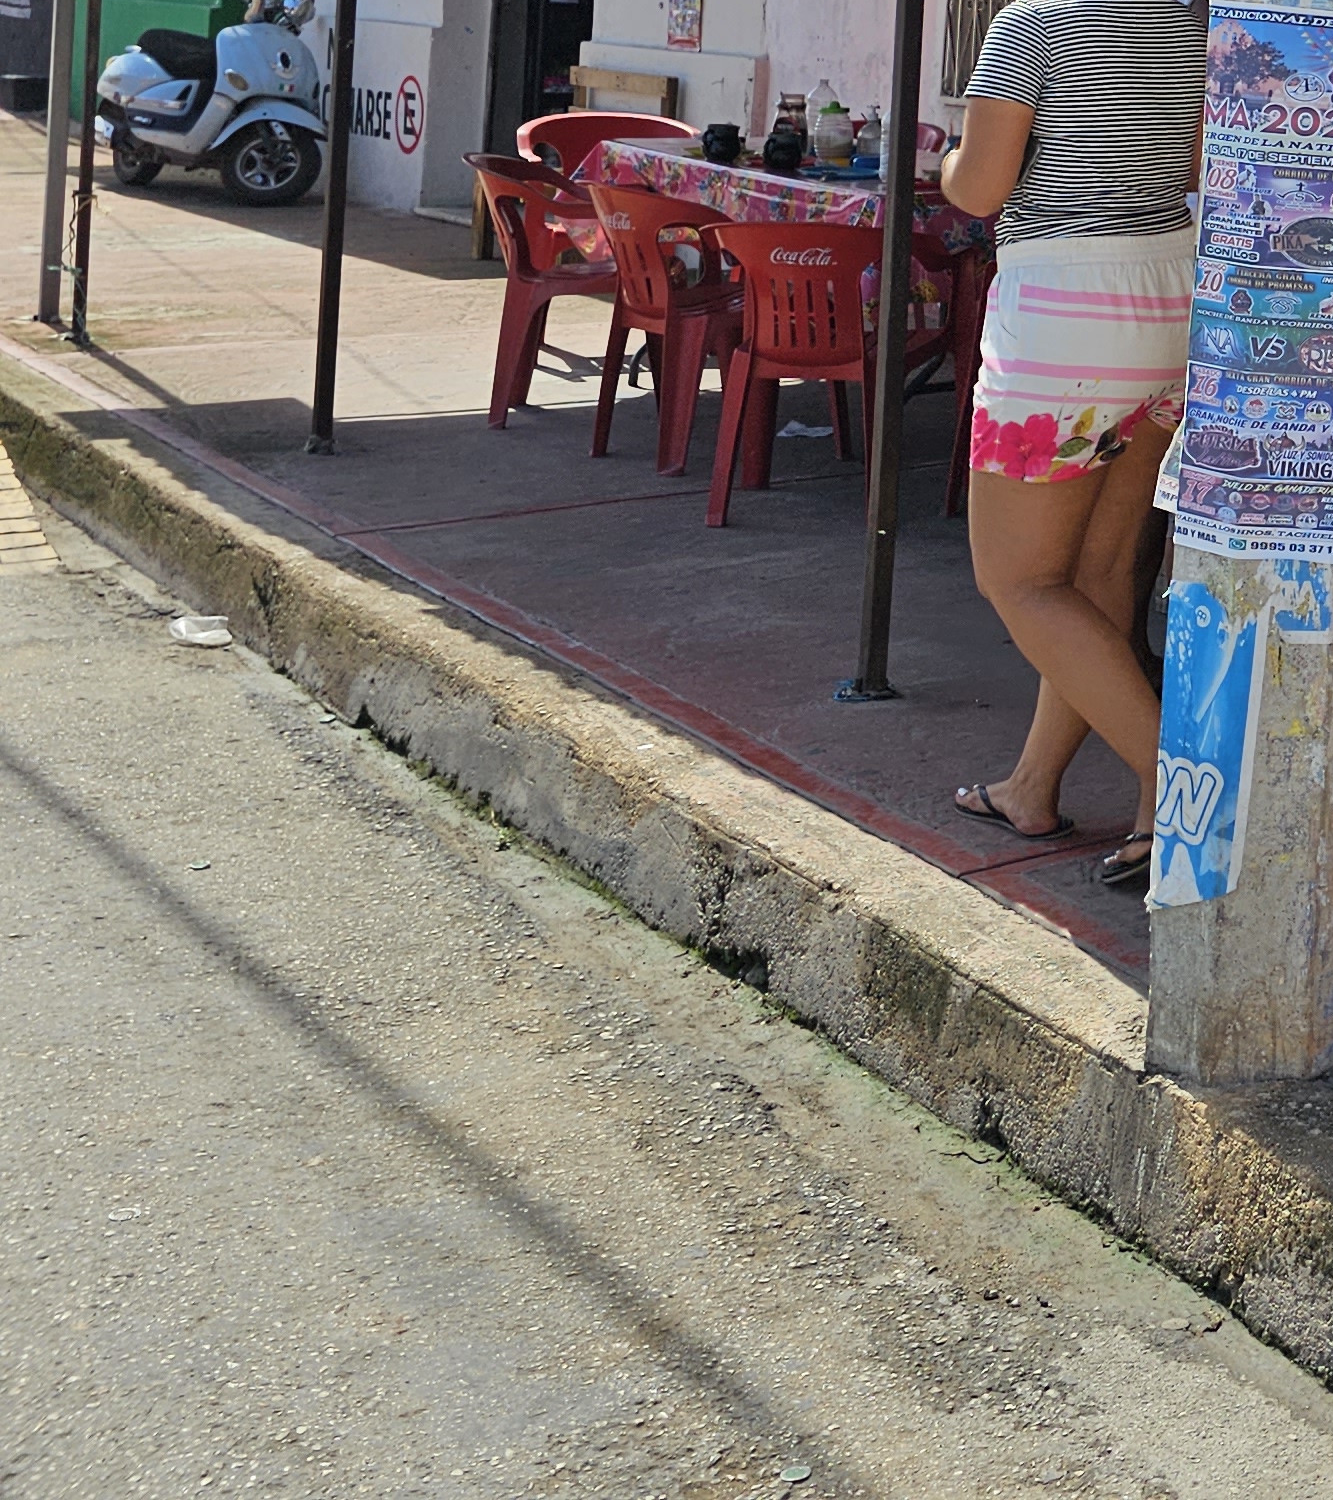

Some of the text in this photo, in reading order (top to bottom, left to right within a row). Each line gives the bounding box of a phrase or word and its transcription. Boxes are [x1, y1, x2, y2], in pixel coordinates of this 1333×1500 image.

[1210, 7, 1309, 26] TRADICIONAL
[1205, 132, 1242, 145] IRGEN
[1243, 137, 1259, 146] DE
[1261, 138, 1285, 148] LA
[1220, 146, 1235, 157] AL
[1237, 148, 1246, 158] 17
[1249, 151, 1264, 161] DE
[1207, 166, 1237, 190] 08
[1273, 169, 1314, 180] CORRIDA
[1317, 171, 1329, 180] DE
[1205, 222, 1263, 236] TOTALMENTE
[1212, 234, 1302, 249] GRATIS PIKA
[1206, 245, 1258, 261] CON LOS
[1199, 270, 1224, 292] 10
[1268, 281, 1315, 292] PROMESAS
[1275, 271, 1303, 281] GRAN
[1196, 308, 1223, 319] NOCHE
[1235, 315, 1268, 326] BANDA
[1251, 333, 1286, 363] VS
[1191, 375, 1219, 397] 16
[1273, 376, 1312, 387] CORRIDA
[1316, 378, 1327, 387] DE
[1236, 385, 1318, 399] DESDE LAS PM
[1188, 408, 1214, 421] GRAN
[1216, 414, 1249, 429] NOCHE
[1250, 419, 1267, 430] DE
[1271, 422, 1316, 433] BANDA
[1321, 424, 1331, 433] Y
[1283, 450, 1297, 460] LUZ
[1181, 480, 1214, 504] 17
[1222, 478, 1252, 492] DUELO
[1255, 483, 1271, 493] DE
[1177, 514, 1218, 531] UADRILLA
[1250, 541, 1285, 551] 9995
[1289, 544, 1305, 553] 03
[1309, 545, 1324, 554] 37
